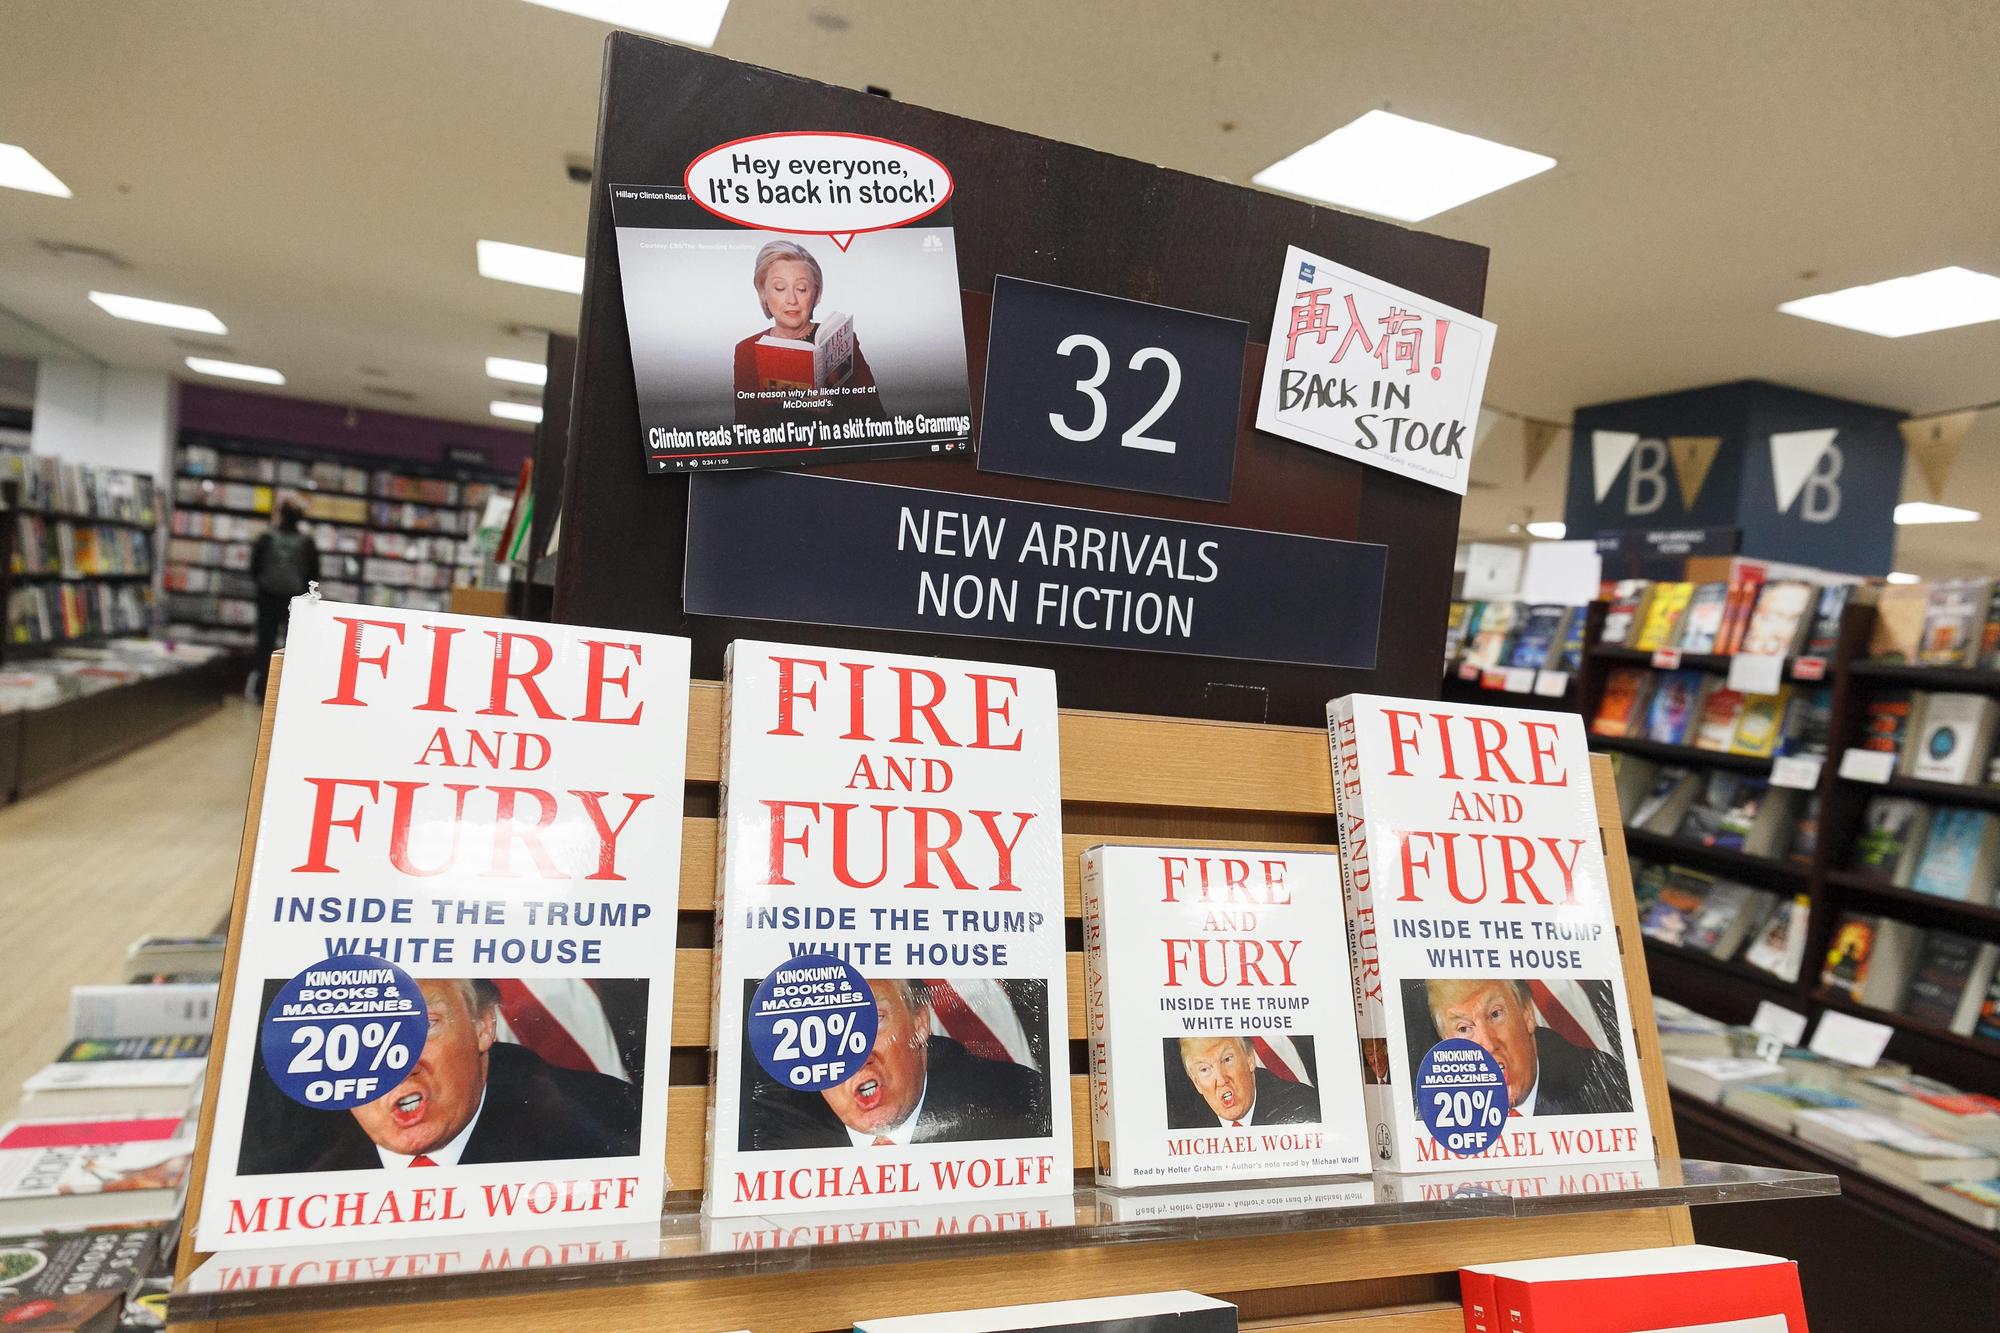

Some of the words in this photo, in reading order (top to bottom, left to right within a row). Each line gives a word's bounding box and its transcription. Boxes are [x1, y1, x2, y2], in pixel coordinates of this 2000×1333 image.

[732, 153, 780, 179] Hey
[788, 159, 908, 180] everyone,
[616, 191, 638, 200] Hillary
[639, 192, 663, 200] Clinton
[709, 178, 749, 204] It's
[757, 179, 821, 204] back
[829, 179, 850, 203] in
[859, 179, 935, 204] stock!
[737, 390, 755, 399] One
[757, 390, 786, 398] reason
[788, 389, 805, 399] why
[807, 388, 817, 397] he
[820, 387, 839, 396] liked
[841, 386, 850, 395] to
[852, 386, 866, 394] eat
[867, 385, 876, 393] at
[783, 399, 833, 409] McDonald's.
[1048, 334, 1182, 454] 32
[1279, 369, 1358, 412] BACK
[1371, 380, 1411, 410] IN
[649, 428, 694, 449] Clinton
[696, 425, 732, 447] reads
[733, 424, 760, 445] 'Fire
[762, 422, 786, 444] and
[787, 420, 816, 446] Fury'
[819, 420, 831, 440] in
[833, 424, 841, 439] a
[842, 418, 863, 439] skit
[865, 417, 893, 437] from
[895, 415, 914, 435] the
[915, 413, 970, 436] Grammys
[1355, 414, 1466, 459] STOCK
[1626, 439, 1668, 515] B
[1801, 444, 1843, 523] B
[897, 506, 1006, 560] NEW
[1018, 521, 1219, 583] ARRIVALS
[917, 571, 1018, 622] NON
[1036, 582, 1194, 637] FICTION
[321, 616, 645, 726] FIRE
[766, 655, 1023, 751] FIRE
[413, 727, 552, 771] AND
[1329, 714, 1337, 750] INSIDE
[1379, 708, 1568, 787] FIRE
[845, 754, 954, 793] AND
[1338, 717, 1361, 800] FIRE
[1335, 781, 1344, 818] TRUMP
[1448, 790, 1523, 823] AND
[290, 777, 655, 881] FURY
[757, 799, 1038, 892] FURY
[1339, 823, 1348, 857] WHITE
[1347, 814, 1371, 891] AND
[1393, 829, 1586, 906] FURY
[1158, 856, 1292, 905] FIRE
[1344, 863, 1352, 900] HOUSE
[272, 896, 414, 925] INSIDE
[431, 898, 510, 925] THE
[523, 899, 652, 927] TRUMP
[745, 906, 856, 930] INSIDE
[870, 907, 929, 931] THE
[942, 909, 1044, 932] TRUMP
[1089, 895, 1101, 960] FIRE
[1202, 911, 1257, 931] AND
[1393, 918, 1471, 939] INSIDE
[1479, 919, 1524, 940] THE
[1531, 921, 1602, 941] TRUMP
[324, 937, 455, 963] WHITE
[473, 938, 602, 964] HOUSE
[788, 942, 892, 966] WHITE
[906, 942, 1008, 966] HOUSE
[1160, 938, 1303, 988] FURY
[1349, 919, 1358, 972] MICHAEL
[1355, 976, 1364, 1017] WOLFF
[1356, 904, 1384, 1007] FURY
[1426, 948, 1501, 968] WHITE
[1511, 949, 1582, 969] HOUSE
[305, 968, 395, 987] KINOKUNIYA
[773, 982, 837, 997] BOOKS
[840, 980, 852, 992] &
[776, 966, 847, 984] KINOKUNIYA
[282, 999, 413, 1016] MAGAZINES
[299, 987, 378, 1002] BOOKS
[383, 985, 400, 999] &
[762, 992, 864, 1011] MAGAZINES
[1093, 969, 1104, 1031] AND
[1160, 998, 1214, 1011] INSIDE
[1221, 998, 1251, 1010] THE
[1257, 997, 1310, 1010] TRUMP
[772, 1012, 866, 1061] 20%
[1182, 1017, 1233, 1030] WHITE
[1240, 1016, 1292, 1029] HOUSE
[287, 1021, 409, 1074] 20%
[1433, 1050, 1483, 1063] KINOKUNIYA
[789, 1062, 846, 1086] OFF
[1096, 1040, 1109, 1117] FURY
[1425, 1073, 1497, 1084] MAGAZINES
[1432, 1064, 1476, 1073] BOOKS
[1479, 1063, 1488, 1072] &
[305, 1077, 379, 1103] OFF
[1434, 1090, 1501, 1128] 20%
[1168, 1136, 1257, 1157] MICHAEL
[1262, 1132, 1324, 1151] WOLFF
[1448, 1132, 1488, 1149] OFF
[1549, 1127, 1638, 1155] WOLFF
[733, 1163, 920, 1203] MICHAEL
[929, 1155, 1054, 1191] WOLFF
[1134, 1167, 1153, 1175] Read
[1155, 1167, 1165, 1176] by
[1168, 1166, 1191, 1174] Holter
[1193, 1164, 1222, 1173] Graham
[1231, 1161, 1262, 1170] Author's
[1264, 1160, 1280, 1168] note
[1282, 1159, 1298, 1167] read
[1301, 1158, 1310, 1167] by
[1312, 1157, 1339, 1166] Michael
[1341, 1156, 1360, 1164] Wolff
[224, 1186, 466, 1235] MICHAEL
[480, 1177, 639, 1218] WOLFF
